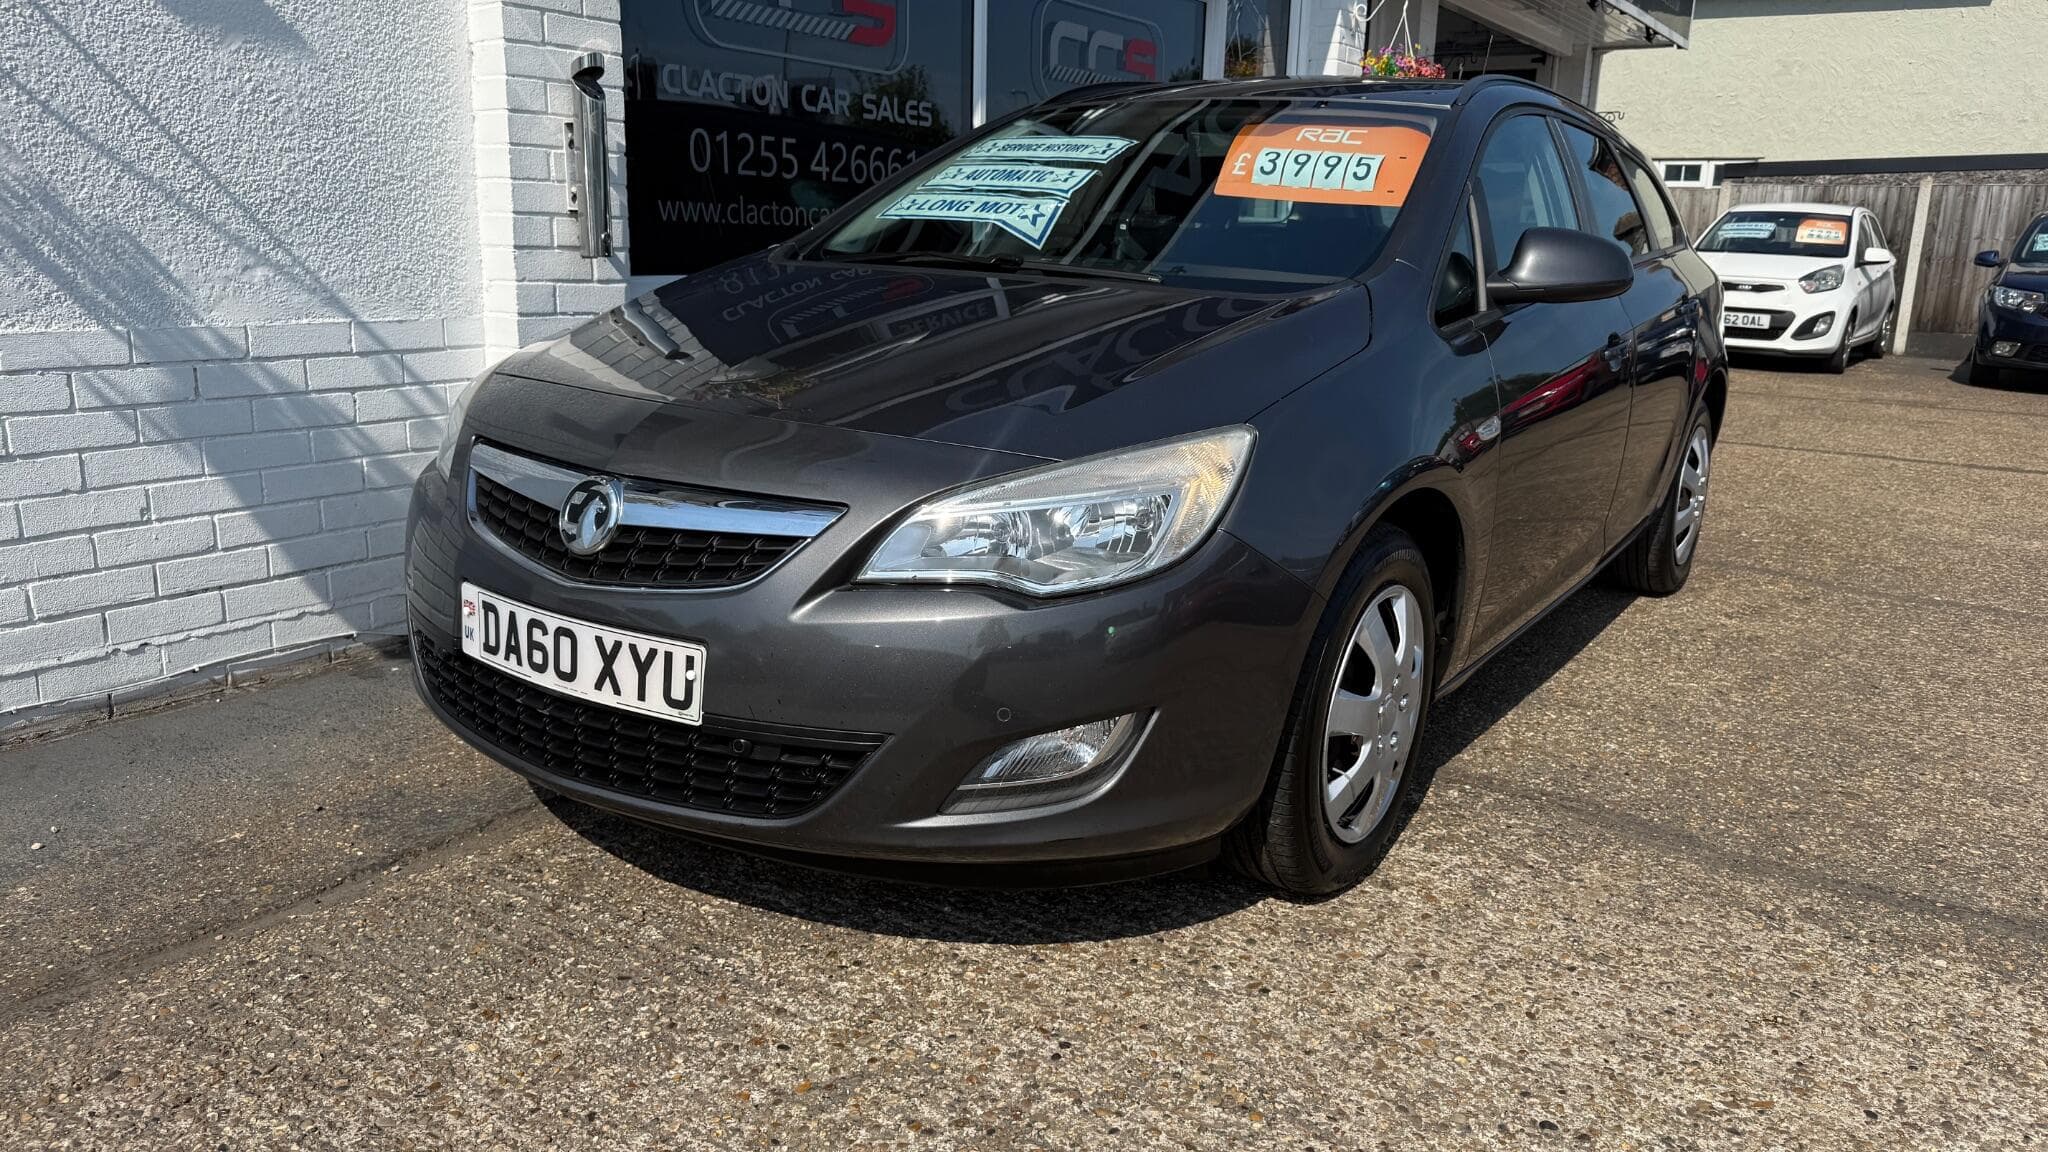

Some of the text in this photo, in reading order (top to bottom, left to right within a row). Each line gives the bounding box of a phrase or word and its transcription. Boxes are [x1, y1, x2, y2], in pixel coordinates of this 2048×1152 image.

[662, 64, 933, 127] CLACTON CAR SALES
[689, 128, 799, 180] 01255
[1001, 143, 1090, 153] SERVICE HISTORY
[963, 168, 1053, 183] AUTOMATIC
[1232, 151, 1376, 181] £ 3995
[659, 195, 838, 227] www.clactonca
[916, 198, 1023, 216] LONG MOT
[1723, 314, 1764, 327] 62 OAL
[464, 625, 475, 642] UK
[482, 600, 695, 711] DA60 XYU
